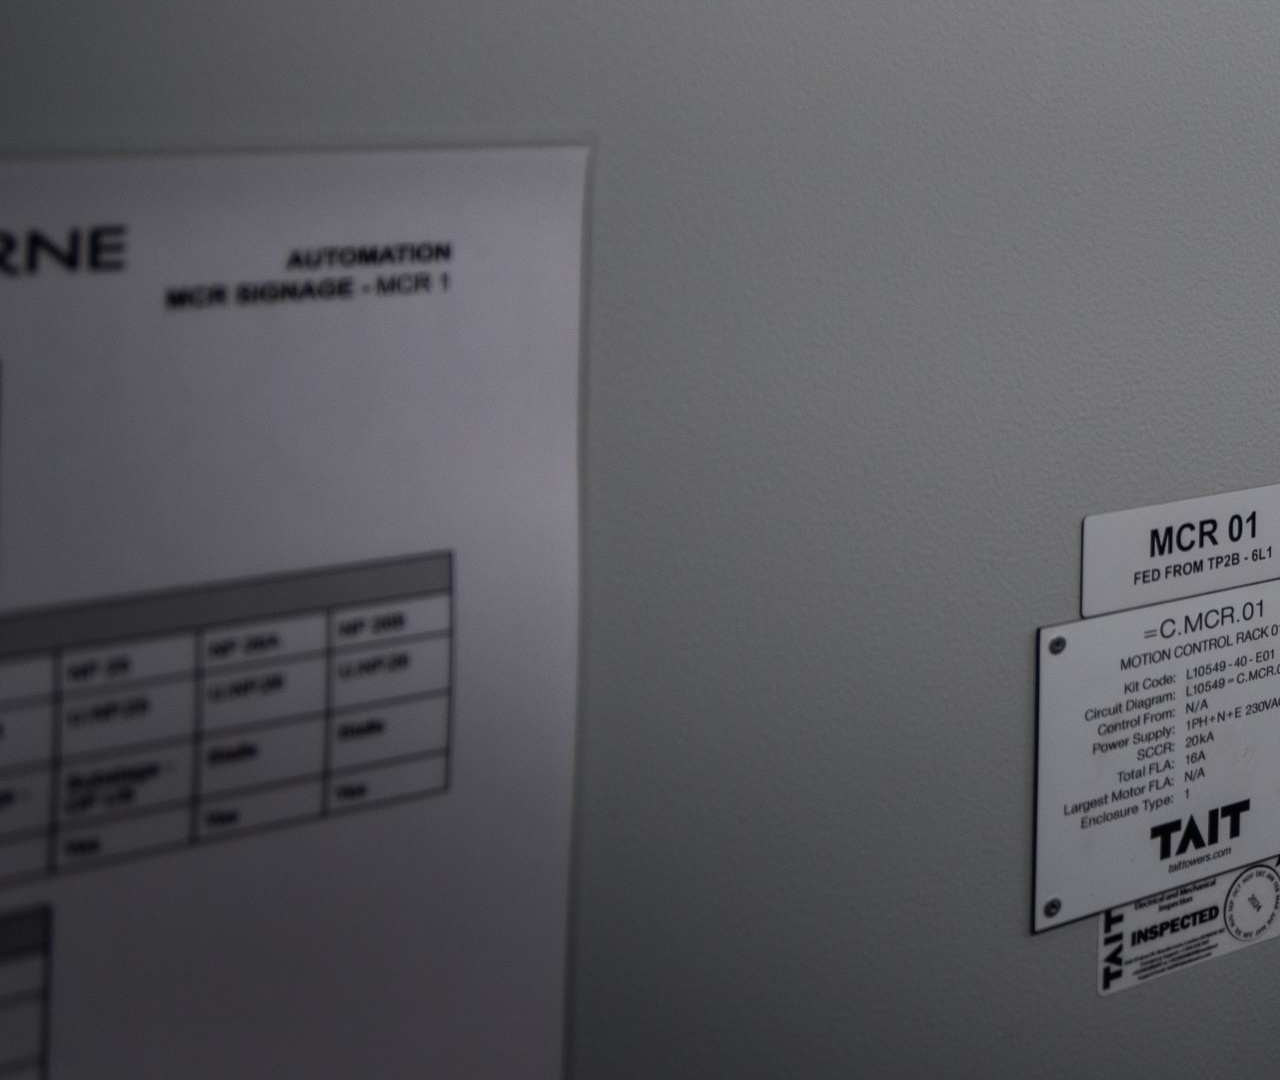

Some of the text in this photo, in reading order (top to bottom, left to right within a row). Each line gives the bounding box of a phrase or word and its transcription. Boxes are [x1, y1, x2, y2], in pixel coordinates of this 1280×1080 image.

[285, 242, 451, 271] AUTOMATION
[165, 285, 226, 309] MCR
[235, 276, 353, 304] SIGNAGE
[376, 272, 432, 297] MCR
[441, 271, 450, 293] 1
[1149, 510, 1257, 558] MCR 01
[1133, 568, 1160, 585] FED
[1164, 560, 1204, 579] FROM
[1206, 553, 1241, 571] TP2B
[1251, 545, 1273, 562] 6L1
[1120, 648, 1171, 671] MOTION
[1173, 635, 1234, 658] CONTROL
[1236, 626, 1269, 644] RACK
[1124, 674, 1176, 694] Kit Code:
[1185, 677, 1226, 697] L10549
[1084, 691, 1176, 722] Circuit Diagram:
[1185, 699, 1209, 715] N/A
[1097, 709, 1175, 737] Control From:
[1092, 725, 1175, 755] Power Supply:
[1136, 741, 1175, 761] SCCR:
[1117, 759, 1175, 783] Total FLA:
[1185, 749, 1206, 765] 16A
[1184, 767, 1206, 783] N/A
[1063, 776, 1175, 817] Largest Motor FLA:
[1184, 788, 1190, 799] 1
[1080, 794, 1174, 829] Enclosure Type:
[1150, 798, 1250, 860] TAIT
[1168, 846, 1232, 874] taittowers.com
[1134, 878, 1216, 910] Electrical and Mechanical
[1232, 883, 1241, 898] OCT
[1242, 872, 1254, 885] NOV
[1158, 896, 1193, 912] Inspection
[1131, 905, 1219, 947] INSPECTED
[1102, 908, 1124, 991] TAIT
